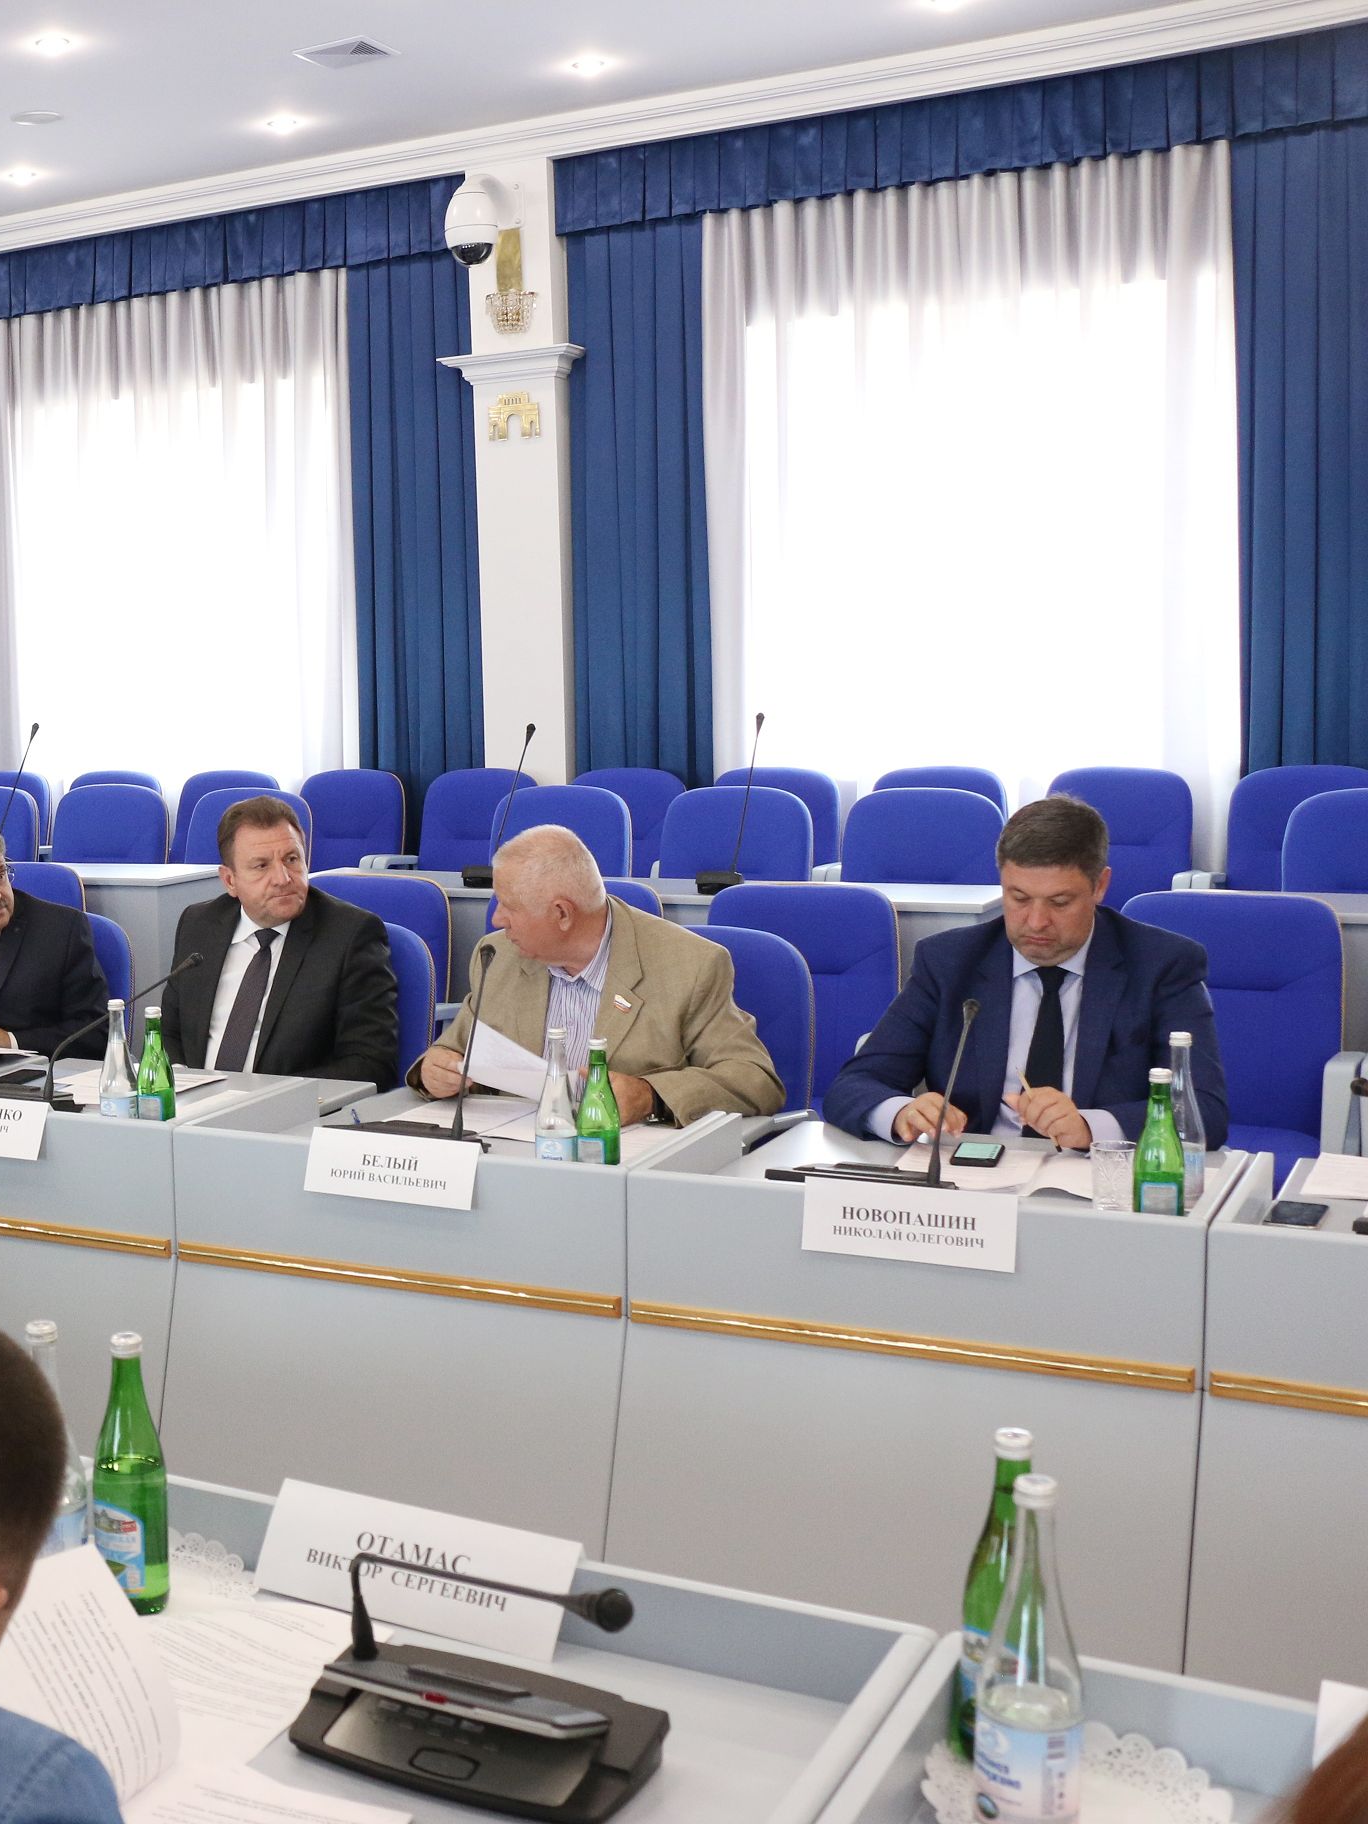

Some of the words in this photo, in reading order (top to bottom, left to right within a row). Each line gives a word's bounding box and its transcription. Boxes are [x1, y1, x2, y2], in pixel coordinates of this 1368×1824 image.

[361, 1153, 419, 1172] БЕЛЫЙ
[330, 1168, 366, 1181] ЮРИЙ
[368, 1172, 447, 1190] ВАСИЛЬЕВИЧ
[841, 1205, 977, 1231] НОВОПАШИН
[832, 1225, 903, 1241] НИКОЛАЙ
[906, 1231, 984, 1249] ОЛЕГОВИЧ
[356, 1531, 471, 1576] ОТАМАС
[391, 1570, 507, 1613] СЕРГЕЕВИЧ
